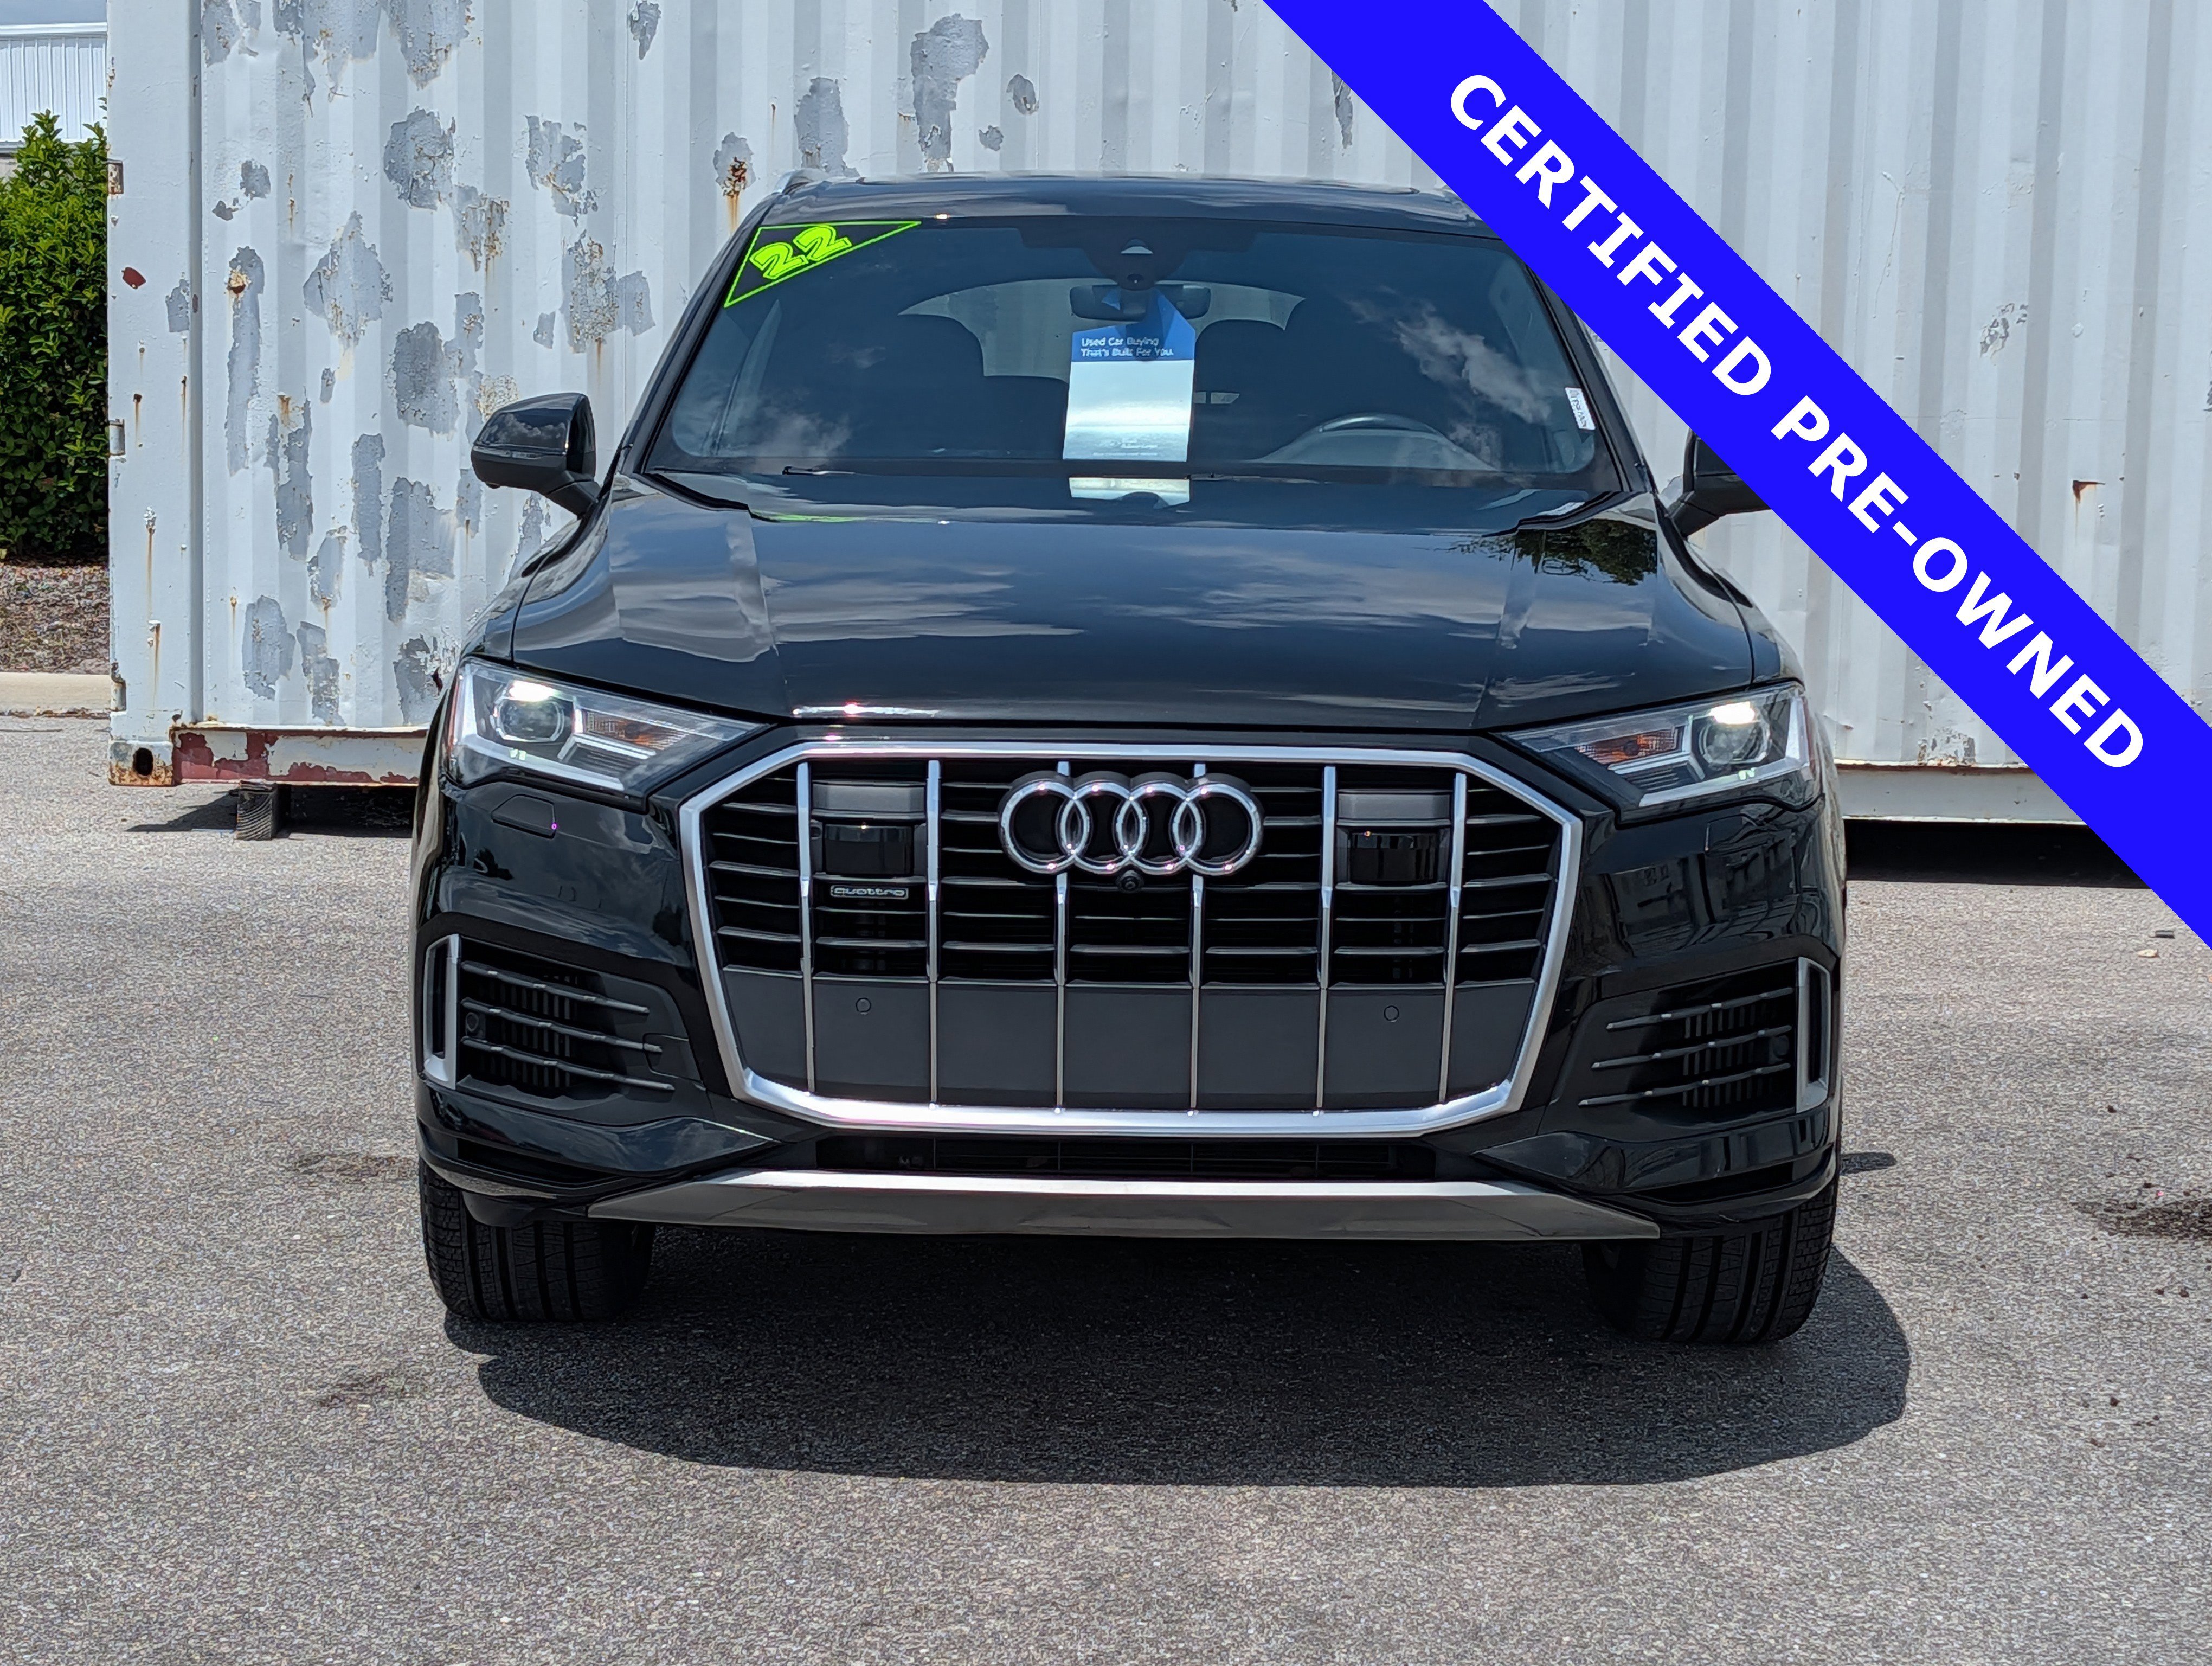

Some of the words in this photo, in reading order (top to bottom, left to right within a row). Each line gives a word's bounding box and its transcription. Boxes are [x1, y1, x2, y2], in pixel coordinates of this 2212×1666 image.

[750, 223, 852, 279] 22
[1081, 337, 1107, 347] Used
[1108, 337, 1124, 346] Car
[1126, 336, 1160, 347] Buying
[1081, 348, 1110, 357] That's
[1136, 348, 1152, 357] For
[832, 887, 906, 897] quattro
